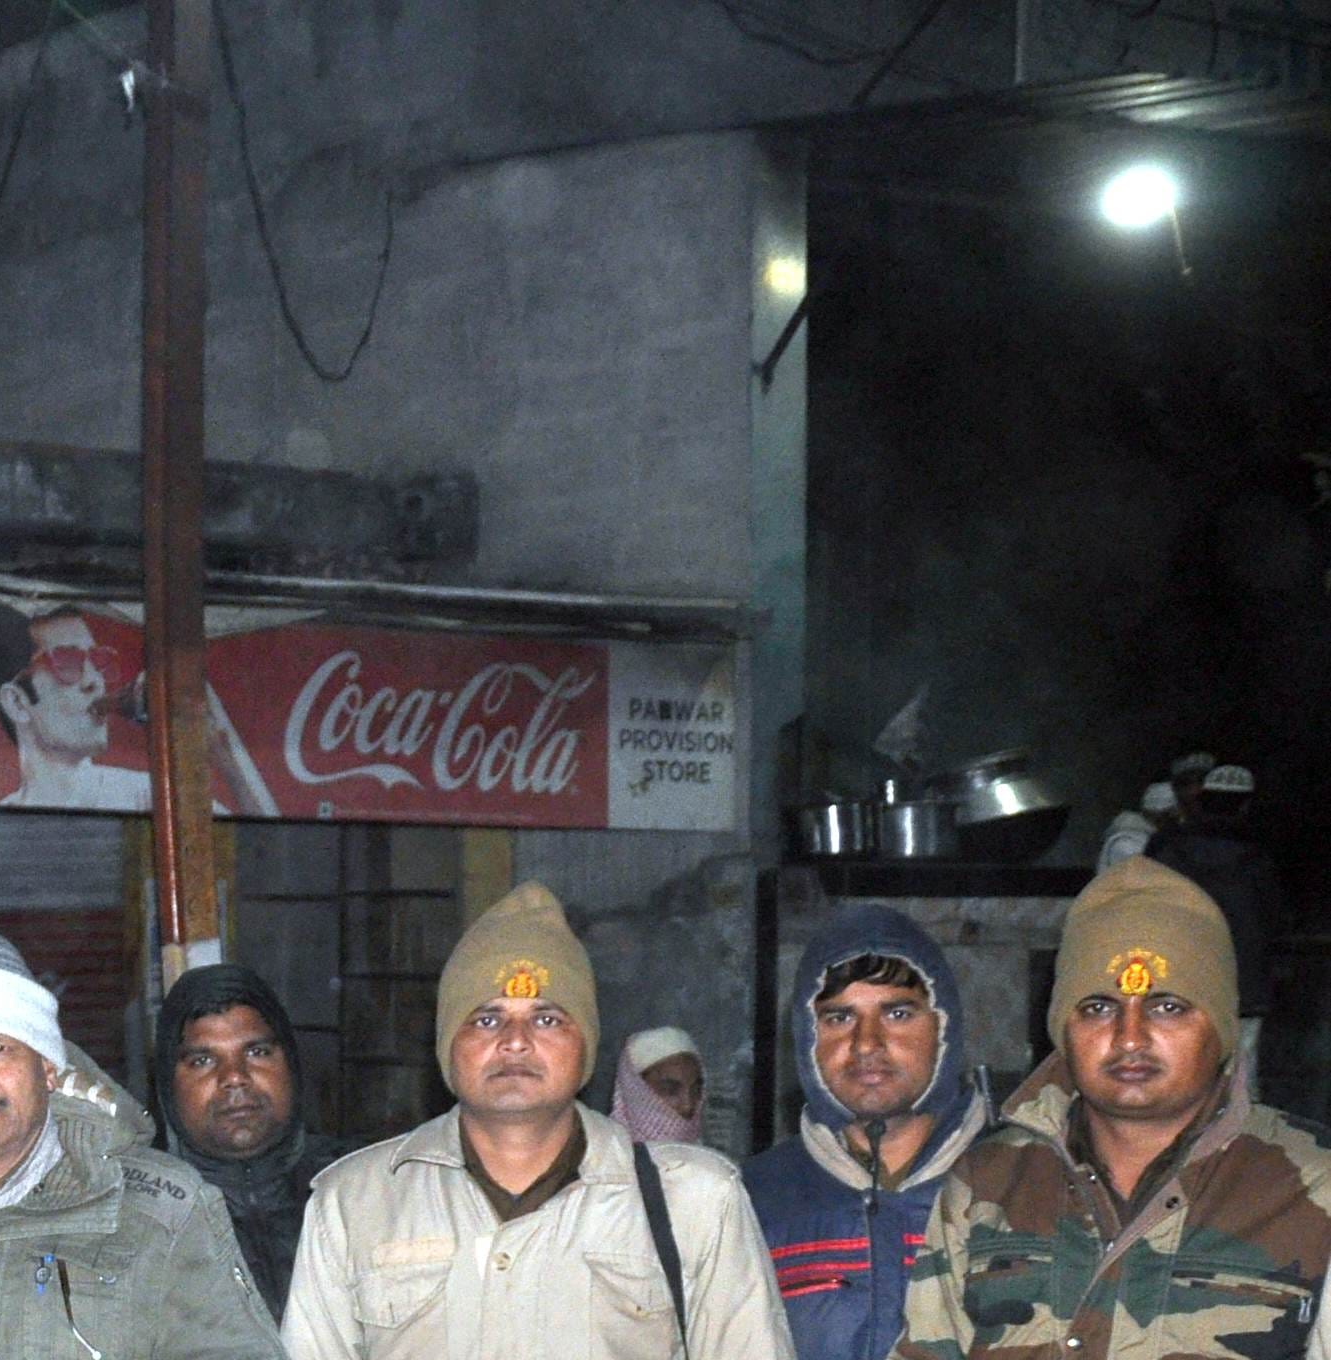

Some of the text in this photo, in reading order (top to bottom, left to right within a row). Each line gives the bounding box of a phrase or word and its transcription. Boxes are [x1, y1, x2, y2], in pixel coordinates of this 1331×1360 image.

[629, 698, 724, 720] PAWAR
[284, 650, 596, 795] Coca-Cola
[619, 728, 733, 753] PROVISION
[642, 760, 711, 784] STORE
